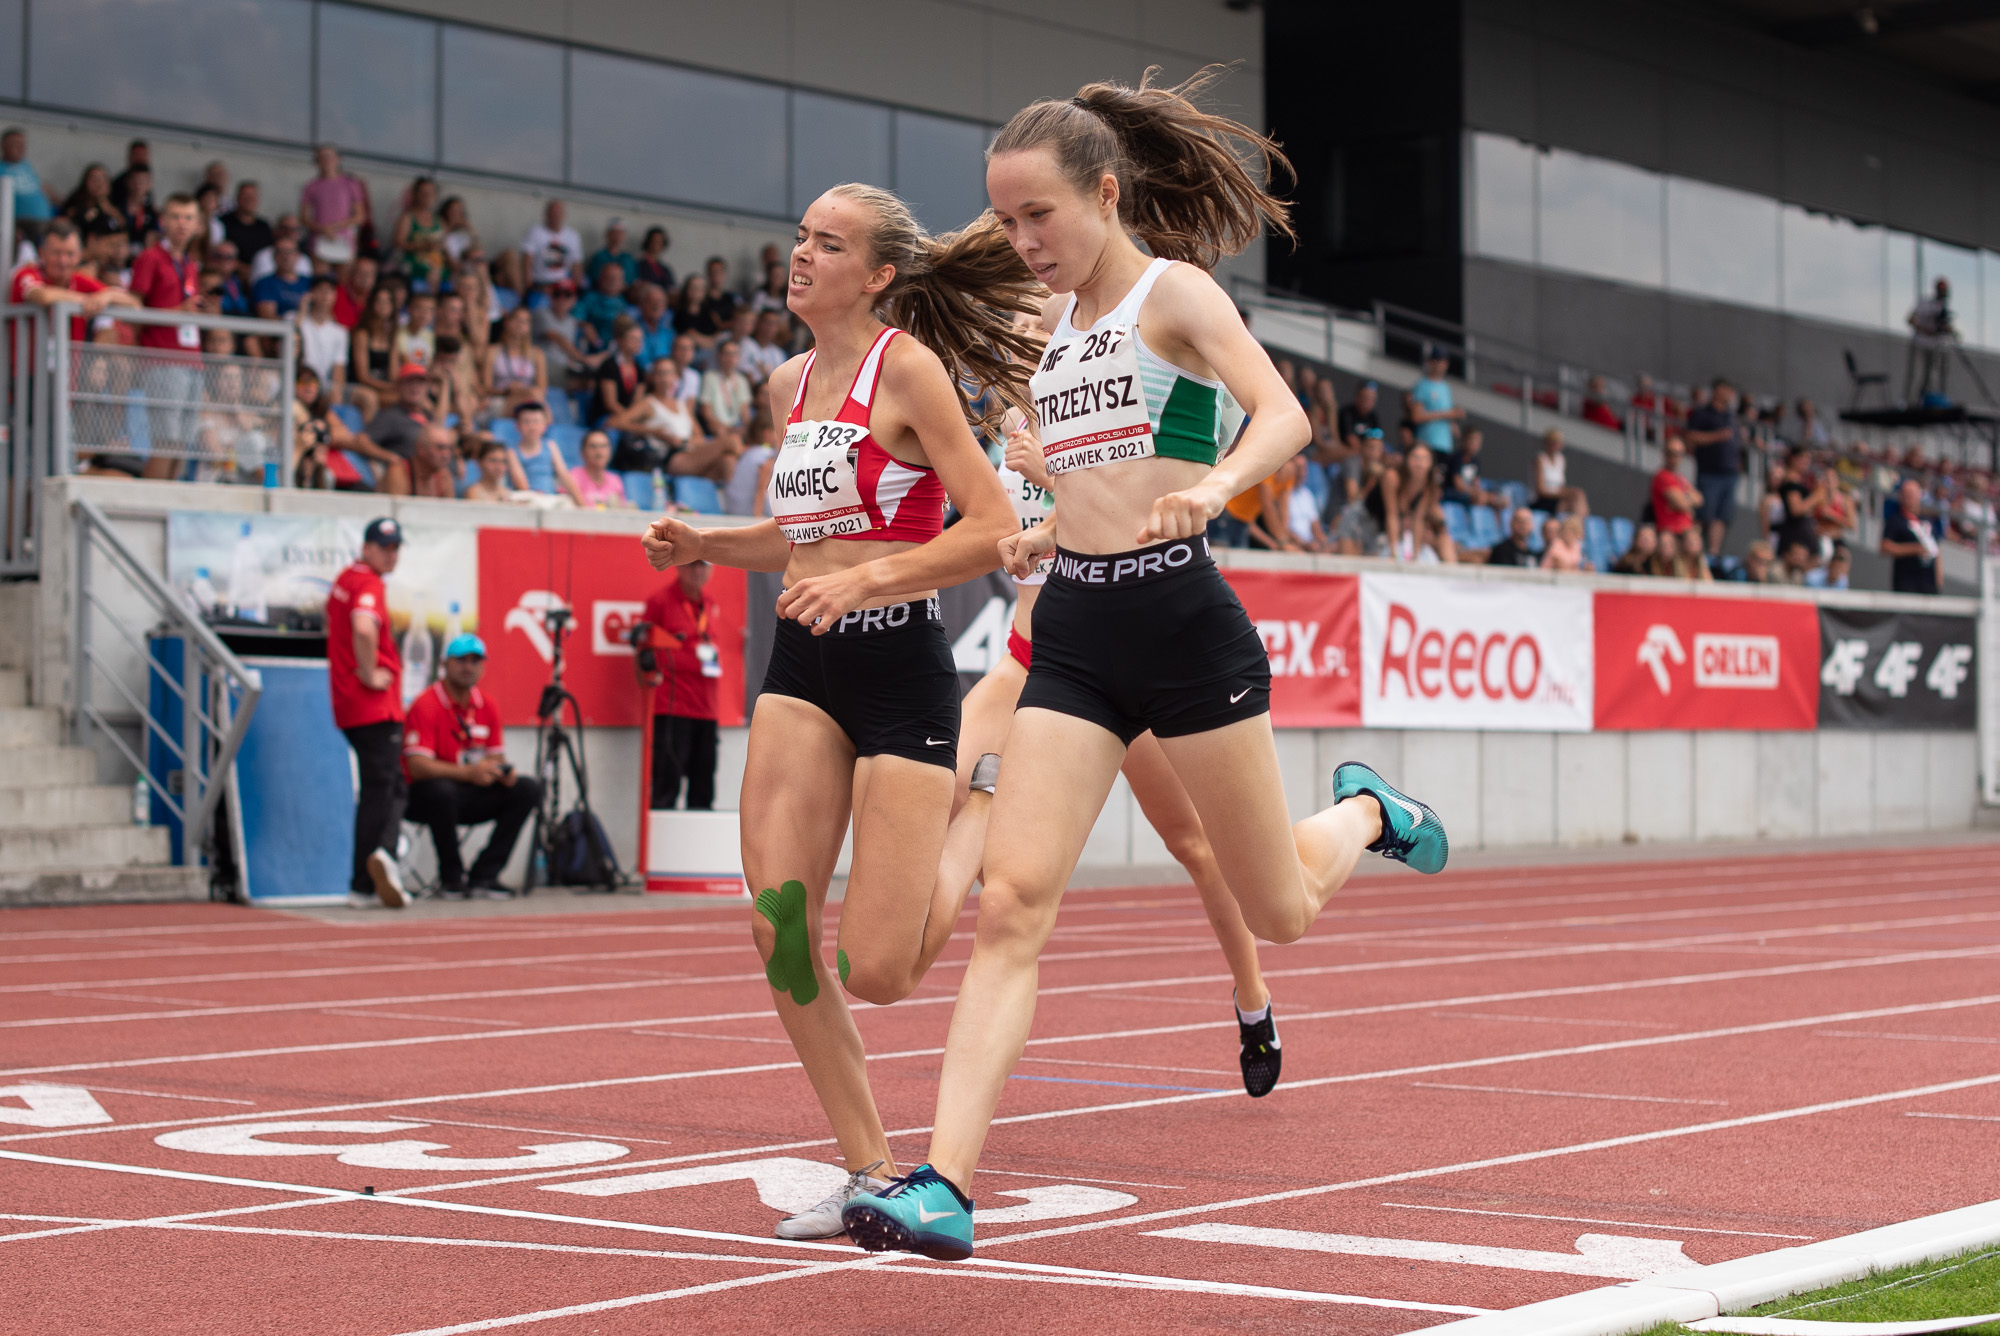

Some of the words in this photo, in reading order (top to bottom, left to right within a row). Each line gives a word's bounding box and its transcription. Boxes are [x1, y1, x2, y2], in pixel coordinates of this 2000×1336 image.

[813, 425, 858, 450] 393
[1097, 431, 1127, 441] POLSKI
[1128, 426, 1144, 435] U18
[1108, 441, 1145, 460] 2021
[775, 460, 839, 500] NAGIĘĆ
[819, 510, 844, 519] POLSKI
[846, 506, 859, 514] U18
[830, 517, 863, 535] 2021
[1055, 554, 1108, 583] NIKE
[1113, 544, 1192, 582] PRO
[839, 602, 910, 633] PRO
[1379, 602, 1542, 701] Reeco
[1702, 644, 1772, 677] ORLEN
[1821, 639, 1868, 696] 4F
[1874, 642, 1923, 698] 4F
[1926, 644, 1972, 699] 4F
